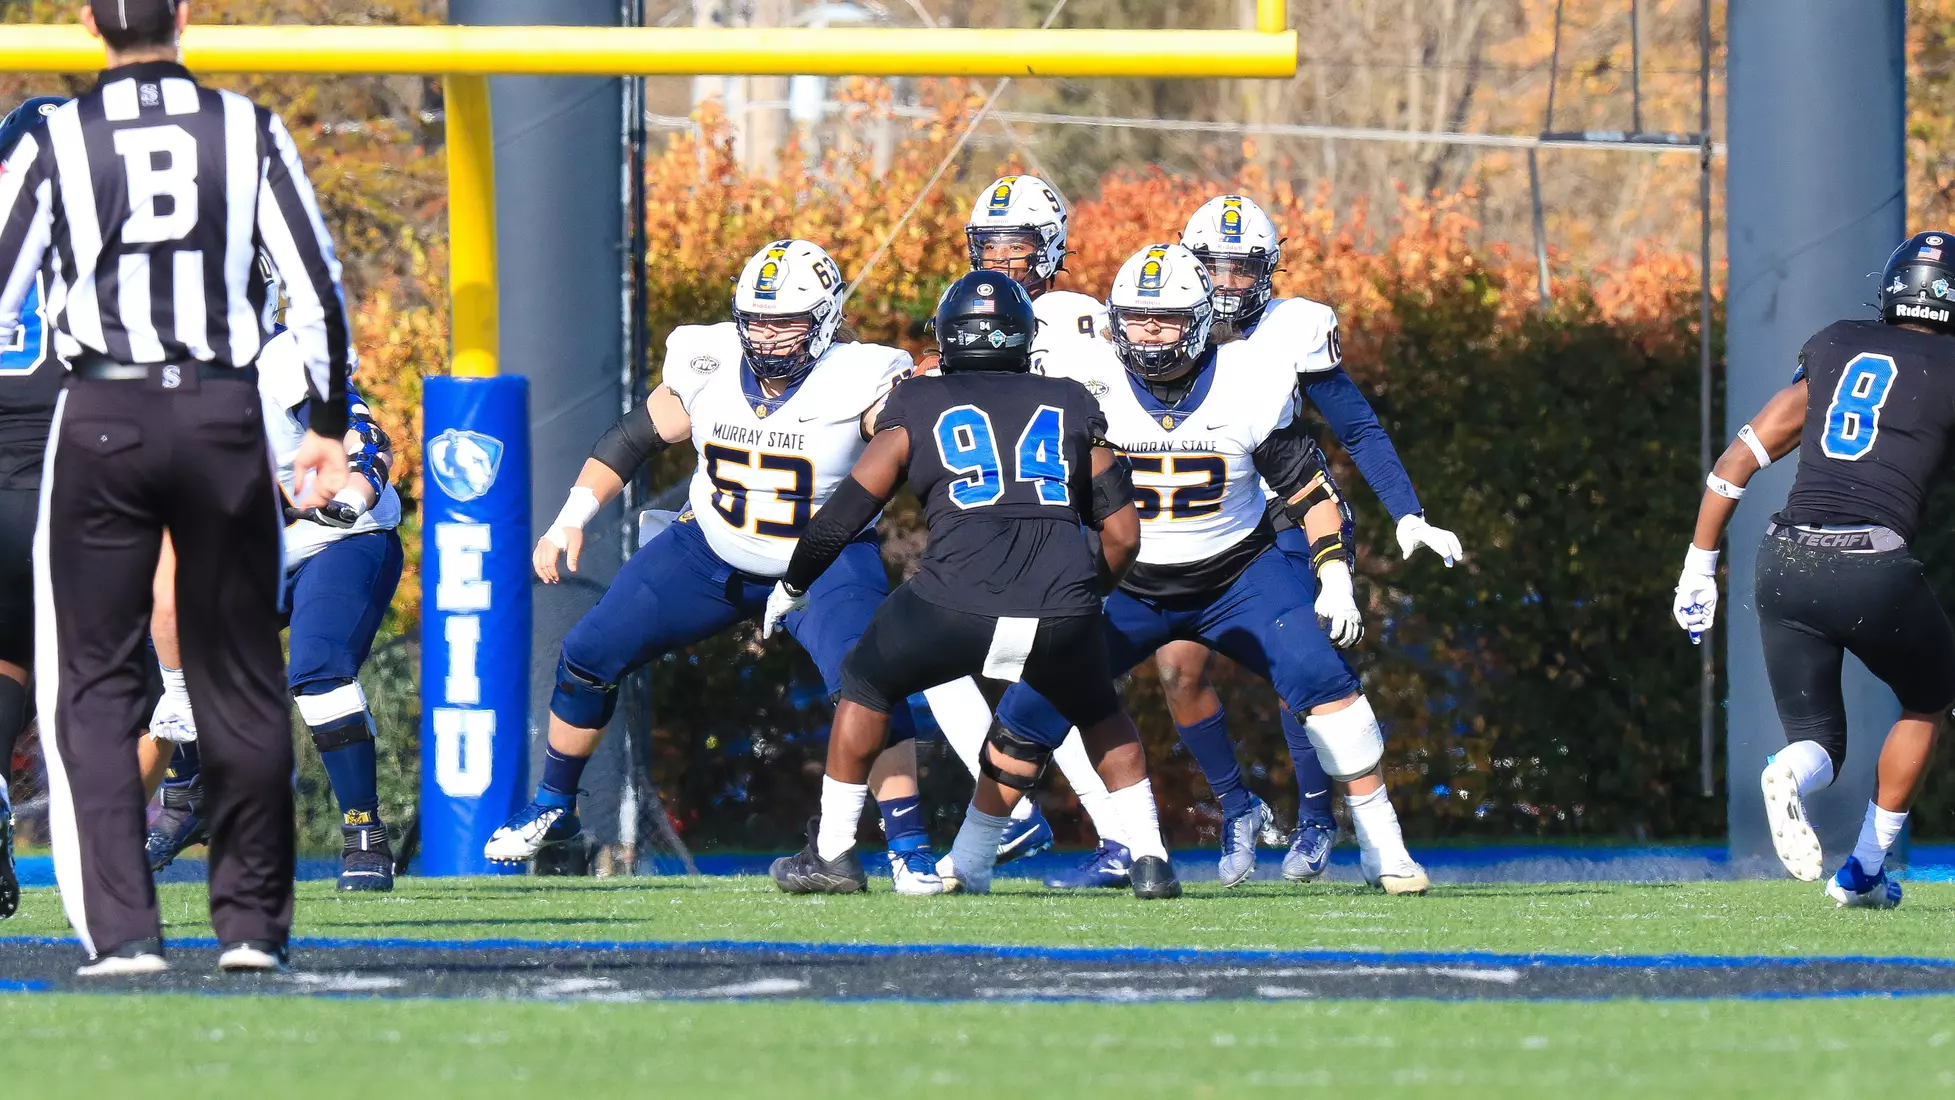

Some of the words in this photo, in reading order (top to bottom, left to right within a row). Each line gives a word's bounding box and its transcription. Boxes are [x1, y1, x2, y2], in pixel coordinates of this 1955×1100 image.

[113, 124, 198, 244] B
[1042, 187, 1061, 213] 9
[812, 256, 840, 291] 63
[980, 321, 991, 331] 94
[1078, 315, 1096, 338] 9
[1896, 304, 1949, 322] Riddell
[162, 365, 182, 388] S
[1821, 352, 1898, 461] 8
[712, 421, 764, 446] MURRAY
[767, 431, 805, 450] STATE
[933, 404, 1070, 510] 94
[704, 441, 815, 540] 63
[433, 523, 497, 798] EIU
